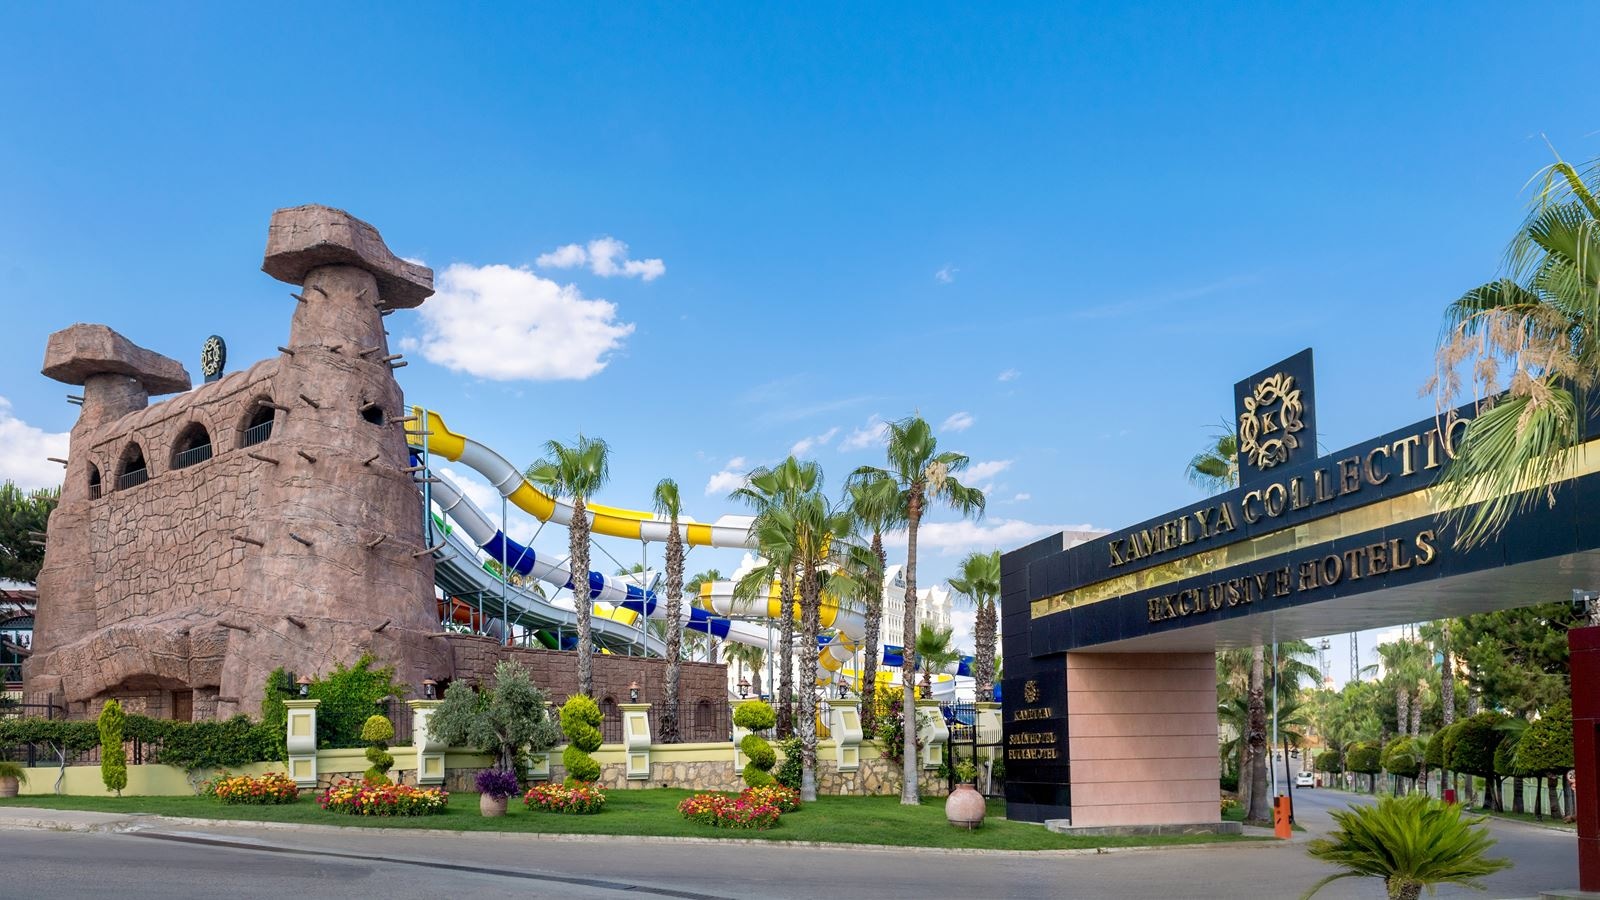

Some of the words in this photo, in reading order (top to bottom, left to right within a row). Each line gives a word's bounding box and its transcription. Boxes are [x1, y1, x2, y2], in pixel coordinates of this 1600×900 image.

[1262, 410, 1279, 435] K
[1108, 502, 1237, 568] KAMELYA
[1242, 418, 1472, 525] COLLECTIO
[1147, 566, 1291, 622] EXCLUSIVE
[1297, 529, 1437, 592] HOTELS
